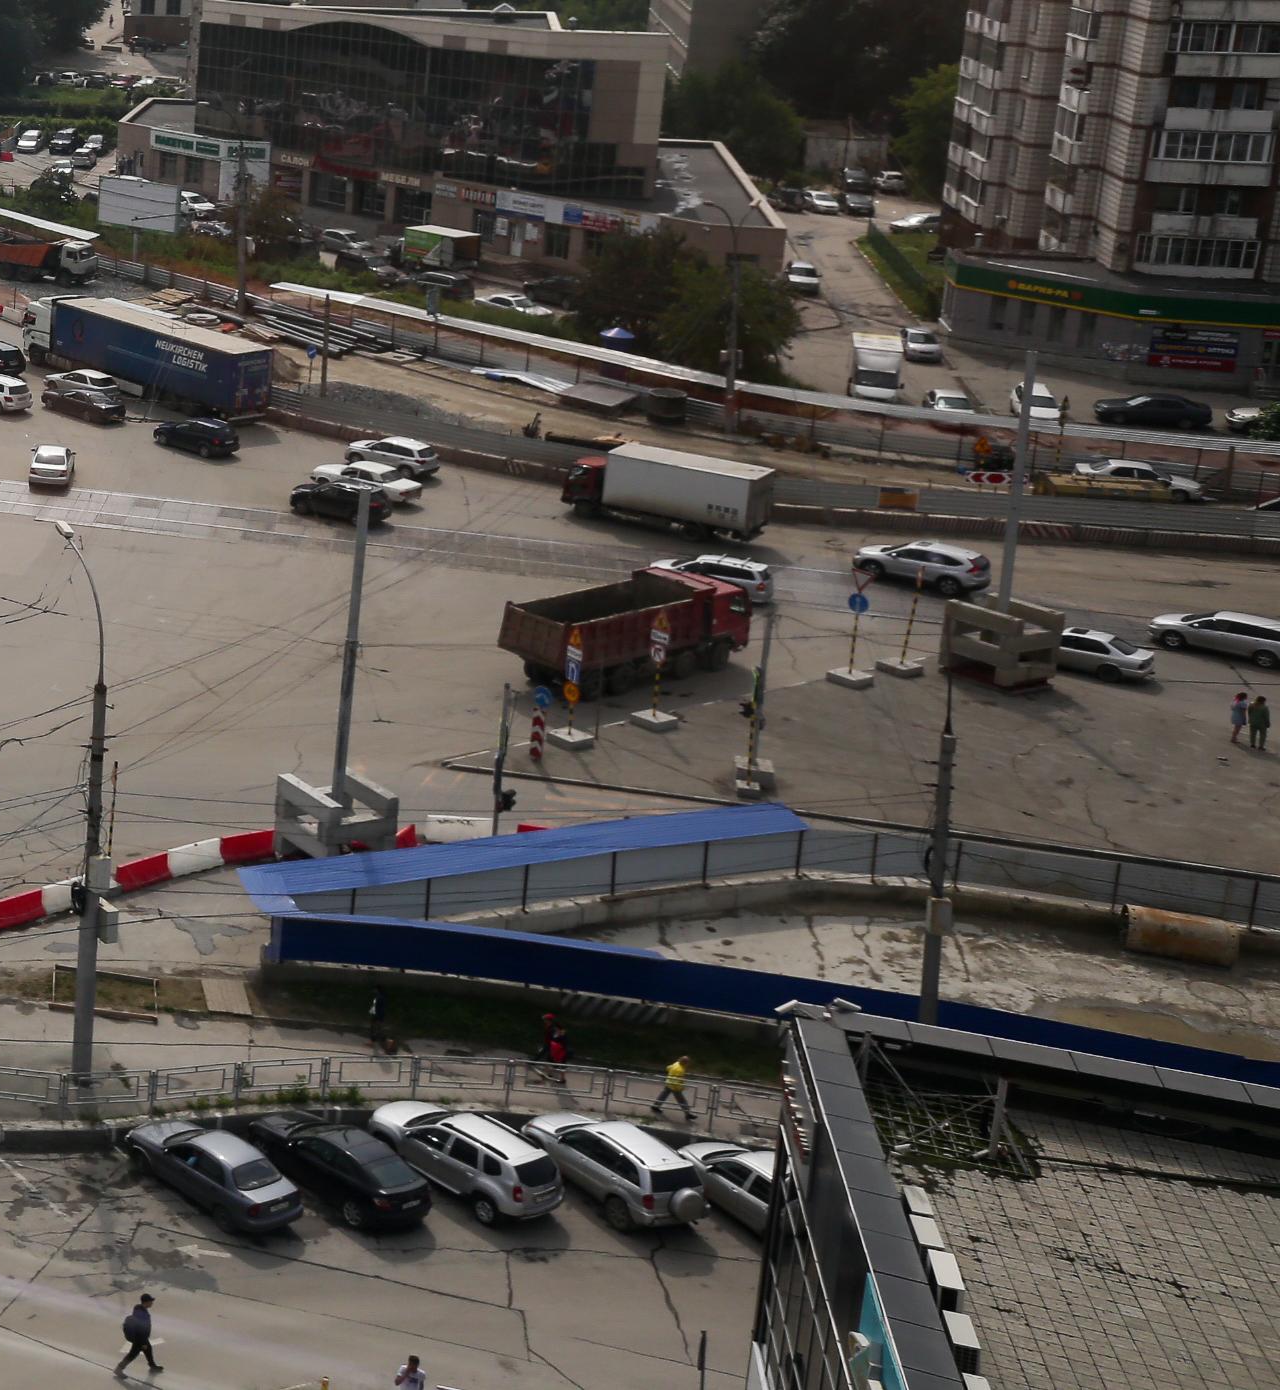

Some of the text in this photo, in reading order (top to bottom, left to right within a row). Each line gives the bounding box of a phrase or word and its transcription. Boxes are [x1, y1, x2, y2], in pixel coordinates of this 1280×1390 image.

[280, 154, 310, 167] САЛОН
[155, 339, 204, 360] NEUKIRCHEN
[172, 354, 208, 373] LOGISTIK
